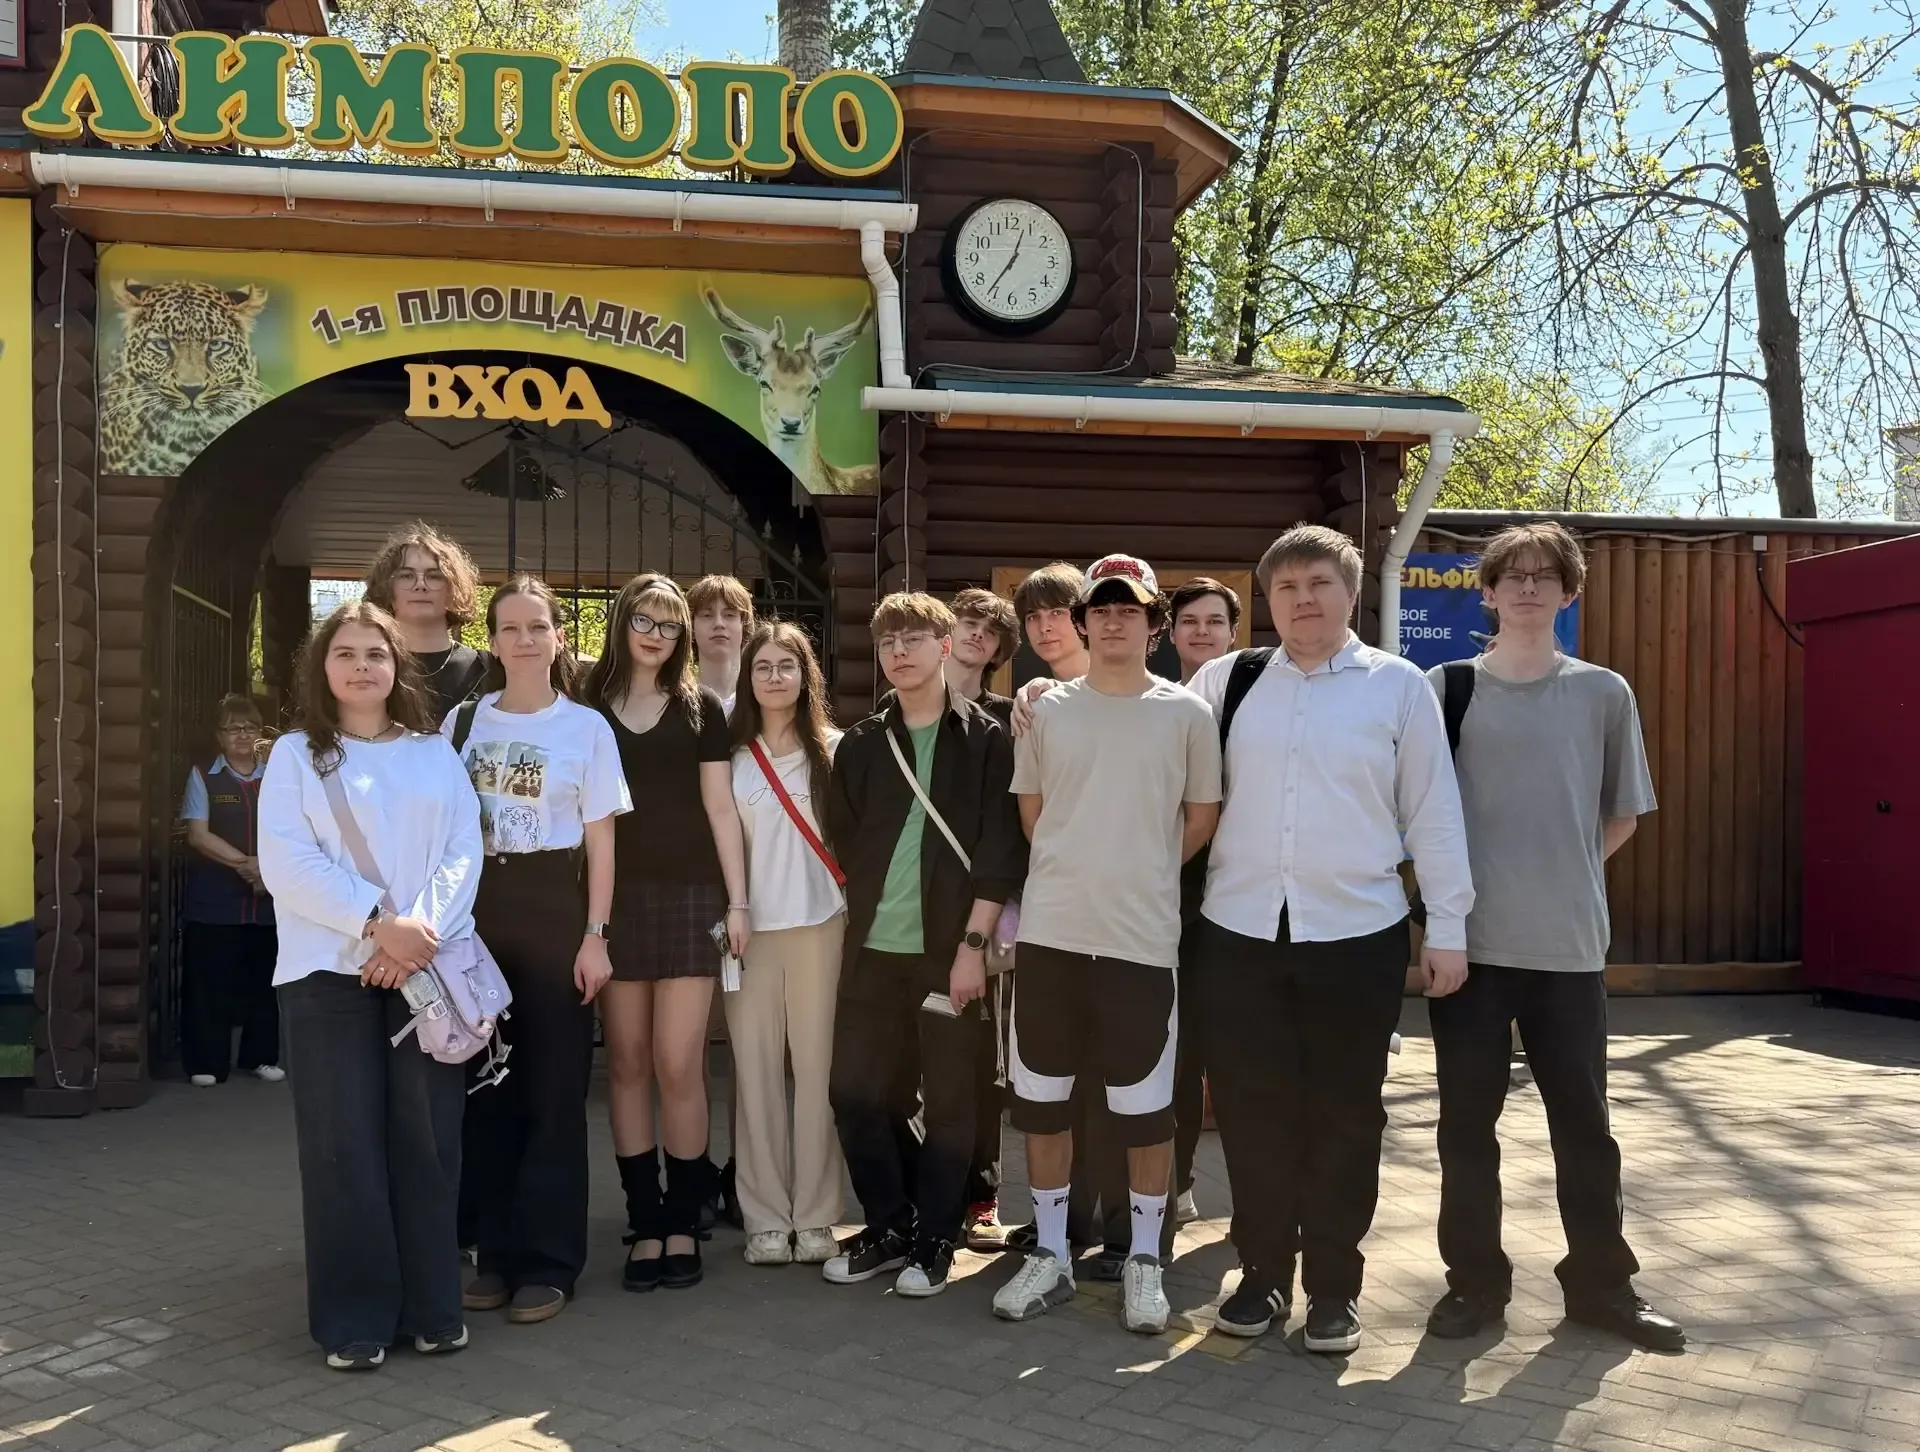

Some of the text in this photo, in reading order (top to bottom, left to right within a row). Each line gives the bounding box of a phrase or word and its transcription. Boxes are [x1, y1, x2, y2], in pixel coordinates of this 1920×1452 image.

[22, 23, 904, 178] ЛИМПОПО
[988, 221, 1001, 235] 11
[1004, 216, 1019, 230] 12
[975, 236, 990, 249] 10
[1039, 235, 1048, 248] 2
[969, 252, 979, 266] 9
[1046, 256, 1056, 269] 3
[975, 272, 985, 286] 8
[1040, 274, 1050, 287] 4
[990, 286, 1000, 299] 7
[1007, 292, 1017, 306] 6
[1028, 287, 1037, 302] 5
[311, 285, 687, 363] 1-я ПЛОЩАДКА
[404, 363, 613, 428] ВХОД
[1400, 608, 1428, 621] ВОЕ
